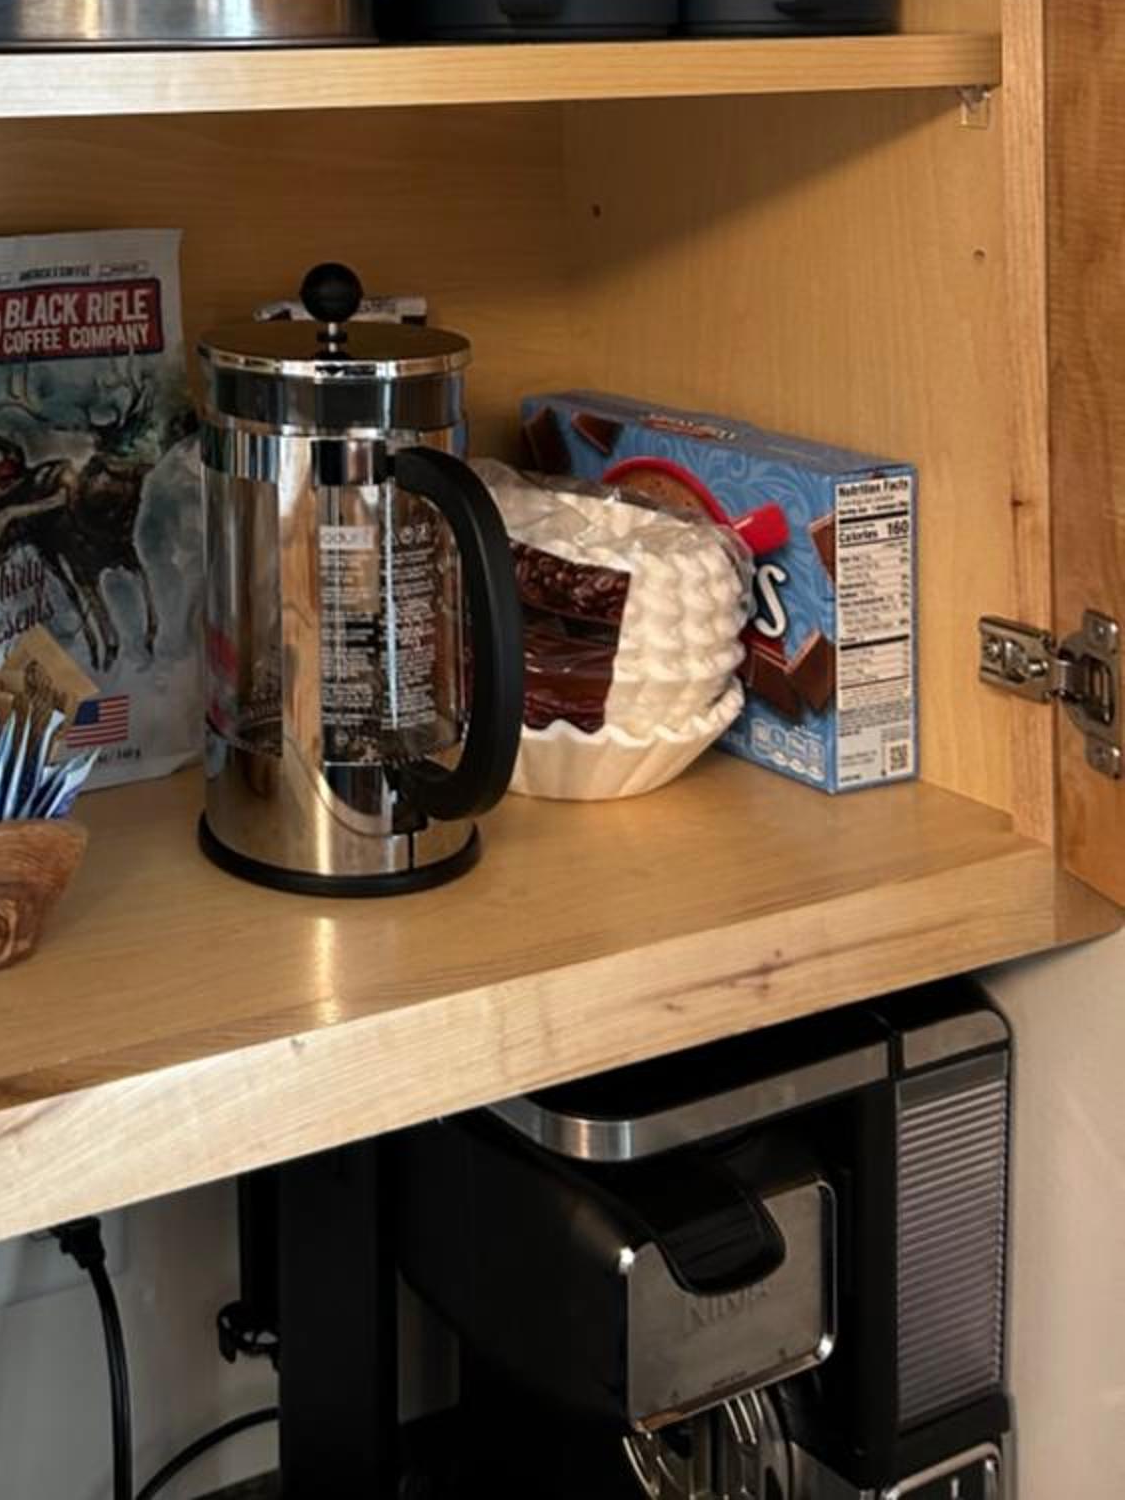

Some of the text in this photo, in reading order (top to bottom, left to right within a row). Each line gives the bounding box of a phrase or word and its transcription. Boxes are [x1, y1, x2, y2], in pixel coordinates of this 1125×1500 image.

[4, 288, 152, 329] BLACK RIFLE
[2, 323, 150, 355] COFFEE COMPANY
[838, 478, 909, 498] Nutrition Facts
[839, 520, 910, 543] Calories 160
